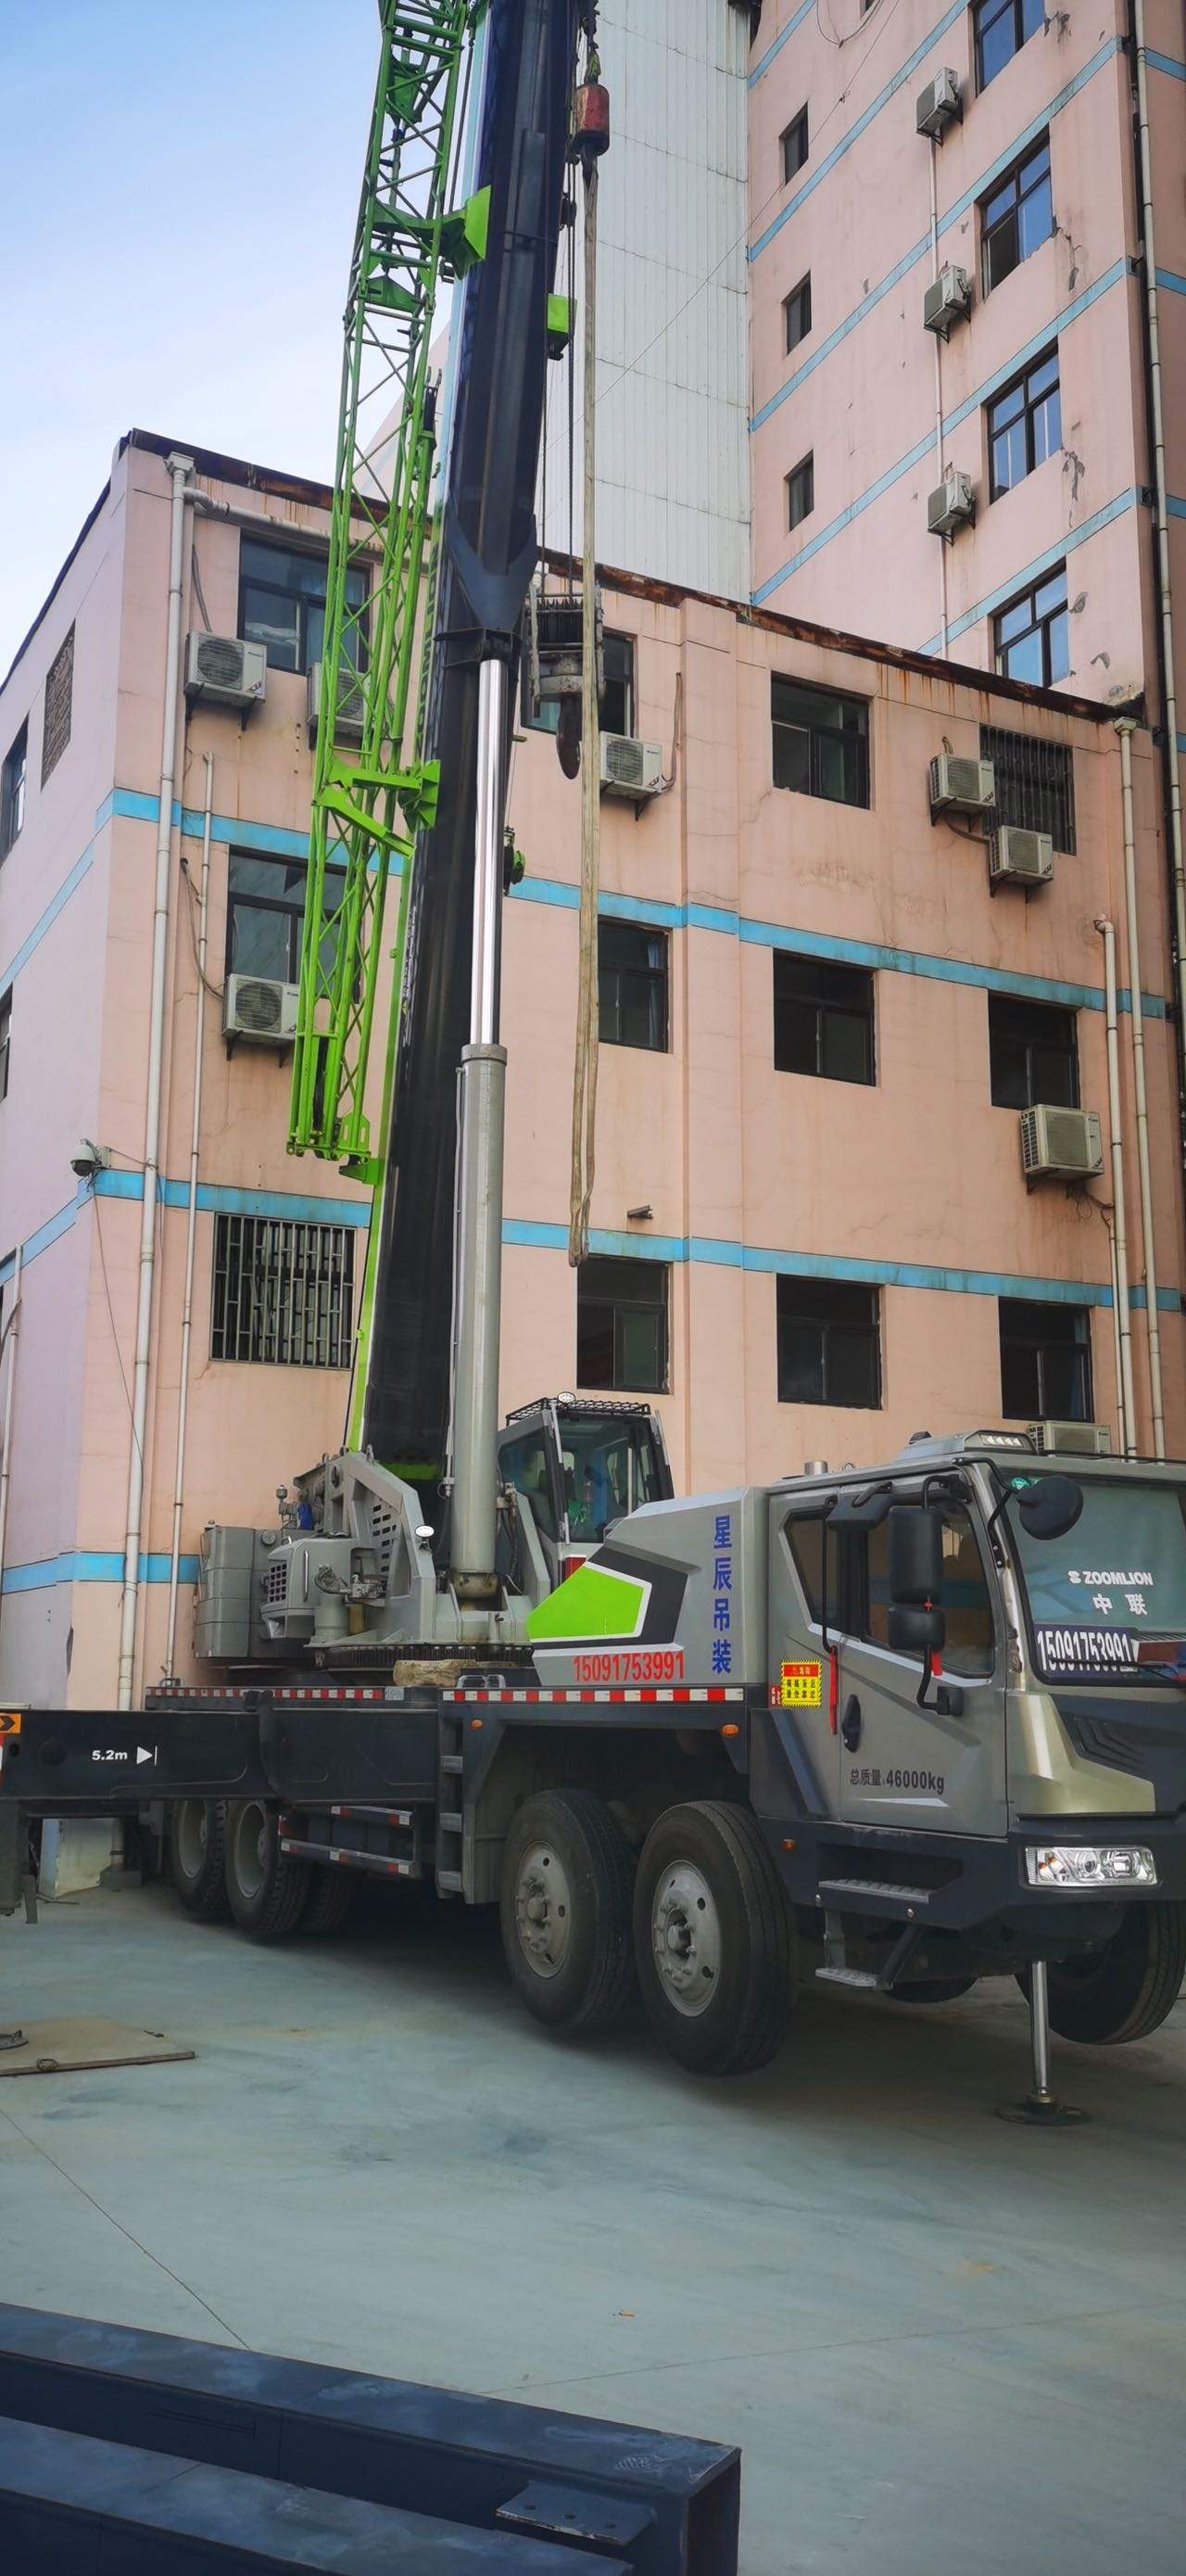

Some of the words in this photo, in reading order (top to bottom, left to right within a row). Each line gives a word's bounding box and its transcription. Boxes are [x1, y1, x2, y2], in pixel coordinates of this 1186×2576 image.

[1082, 1570, 1154, 1586] ZOOMLION
[712, 1514, 733, 1675] 星辰吊装
[1092, 1593, 1148, 1616] 中联
[1037, 1630, 1132, 1671] 15091753991
[574, 1651, 686, 1682] 15091753991
[92, 1749, 128, 1760] 5.2m
